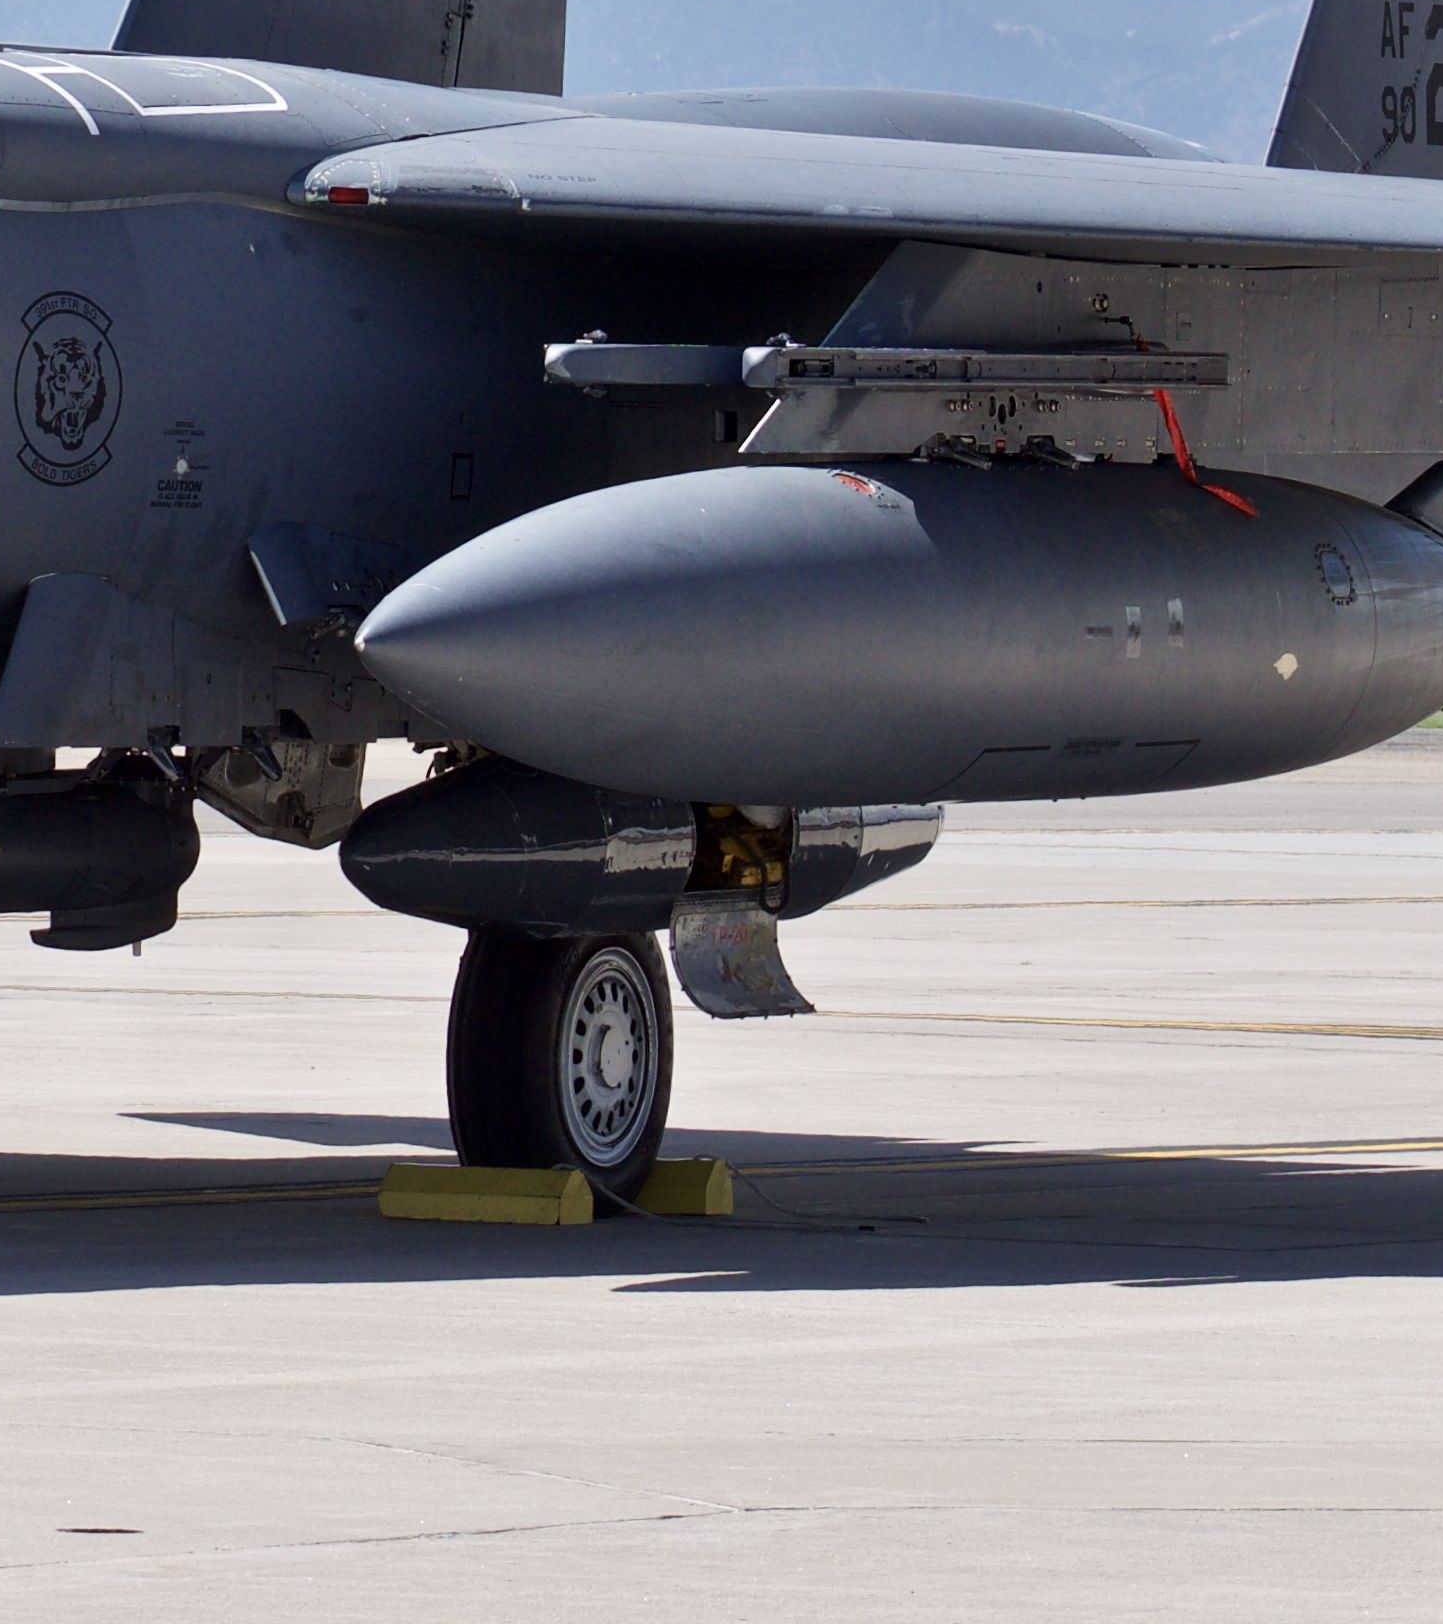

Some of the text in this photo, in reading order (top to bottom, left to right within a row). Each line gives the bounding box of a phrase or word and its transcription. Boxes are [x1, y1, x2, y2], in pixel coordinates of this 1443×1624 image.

[1380, 0, 1416, 59] AF
[1380, 86, 1417, 144] 90
[557, 175, 598, 183] STEP
[60, 297, 79, 311] FTR
[82, 304, 99, 320] SQ
[31, 458, 98, 481] BOLD TIGERS
[157, 479, 203, 492] CAUTION
